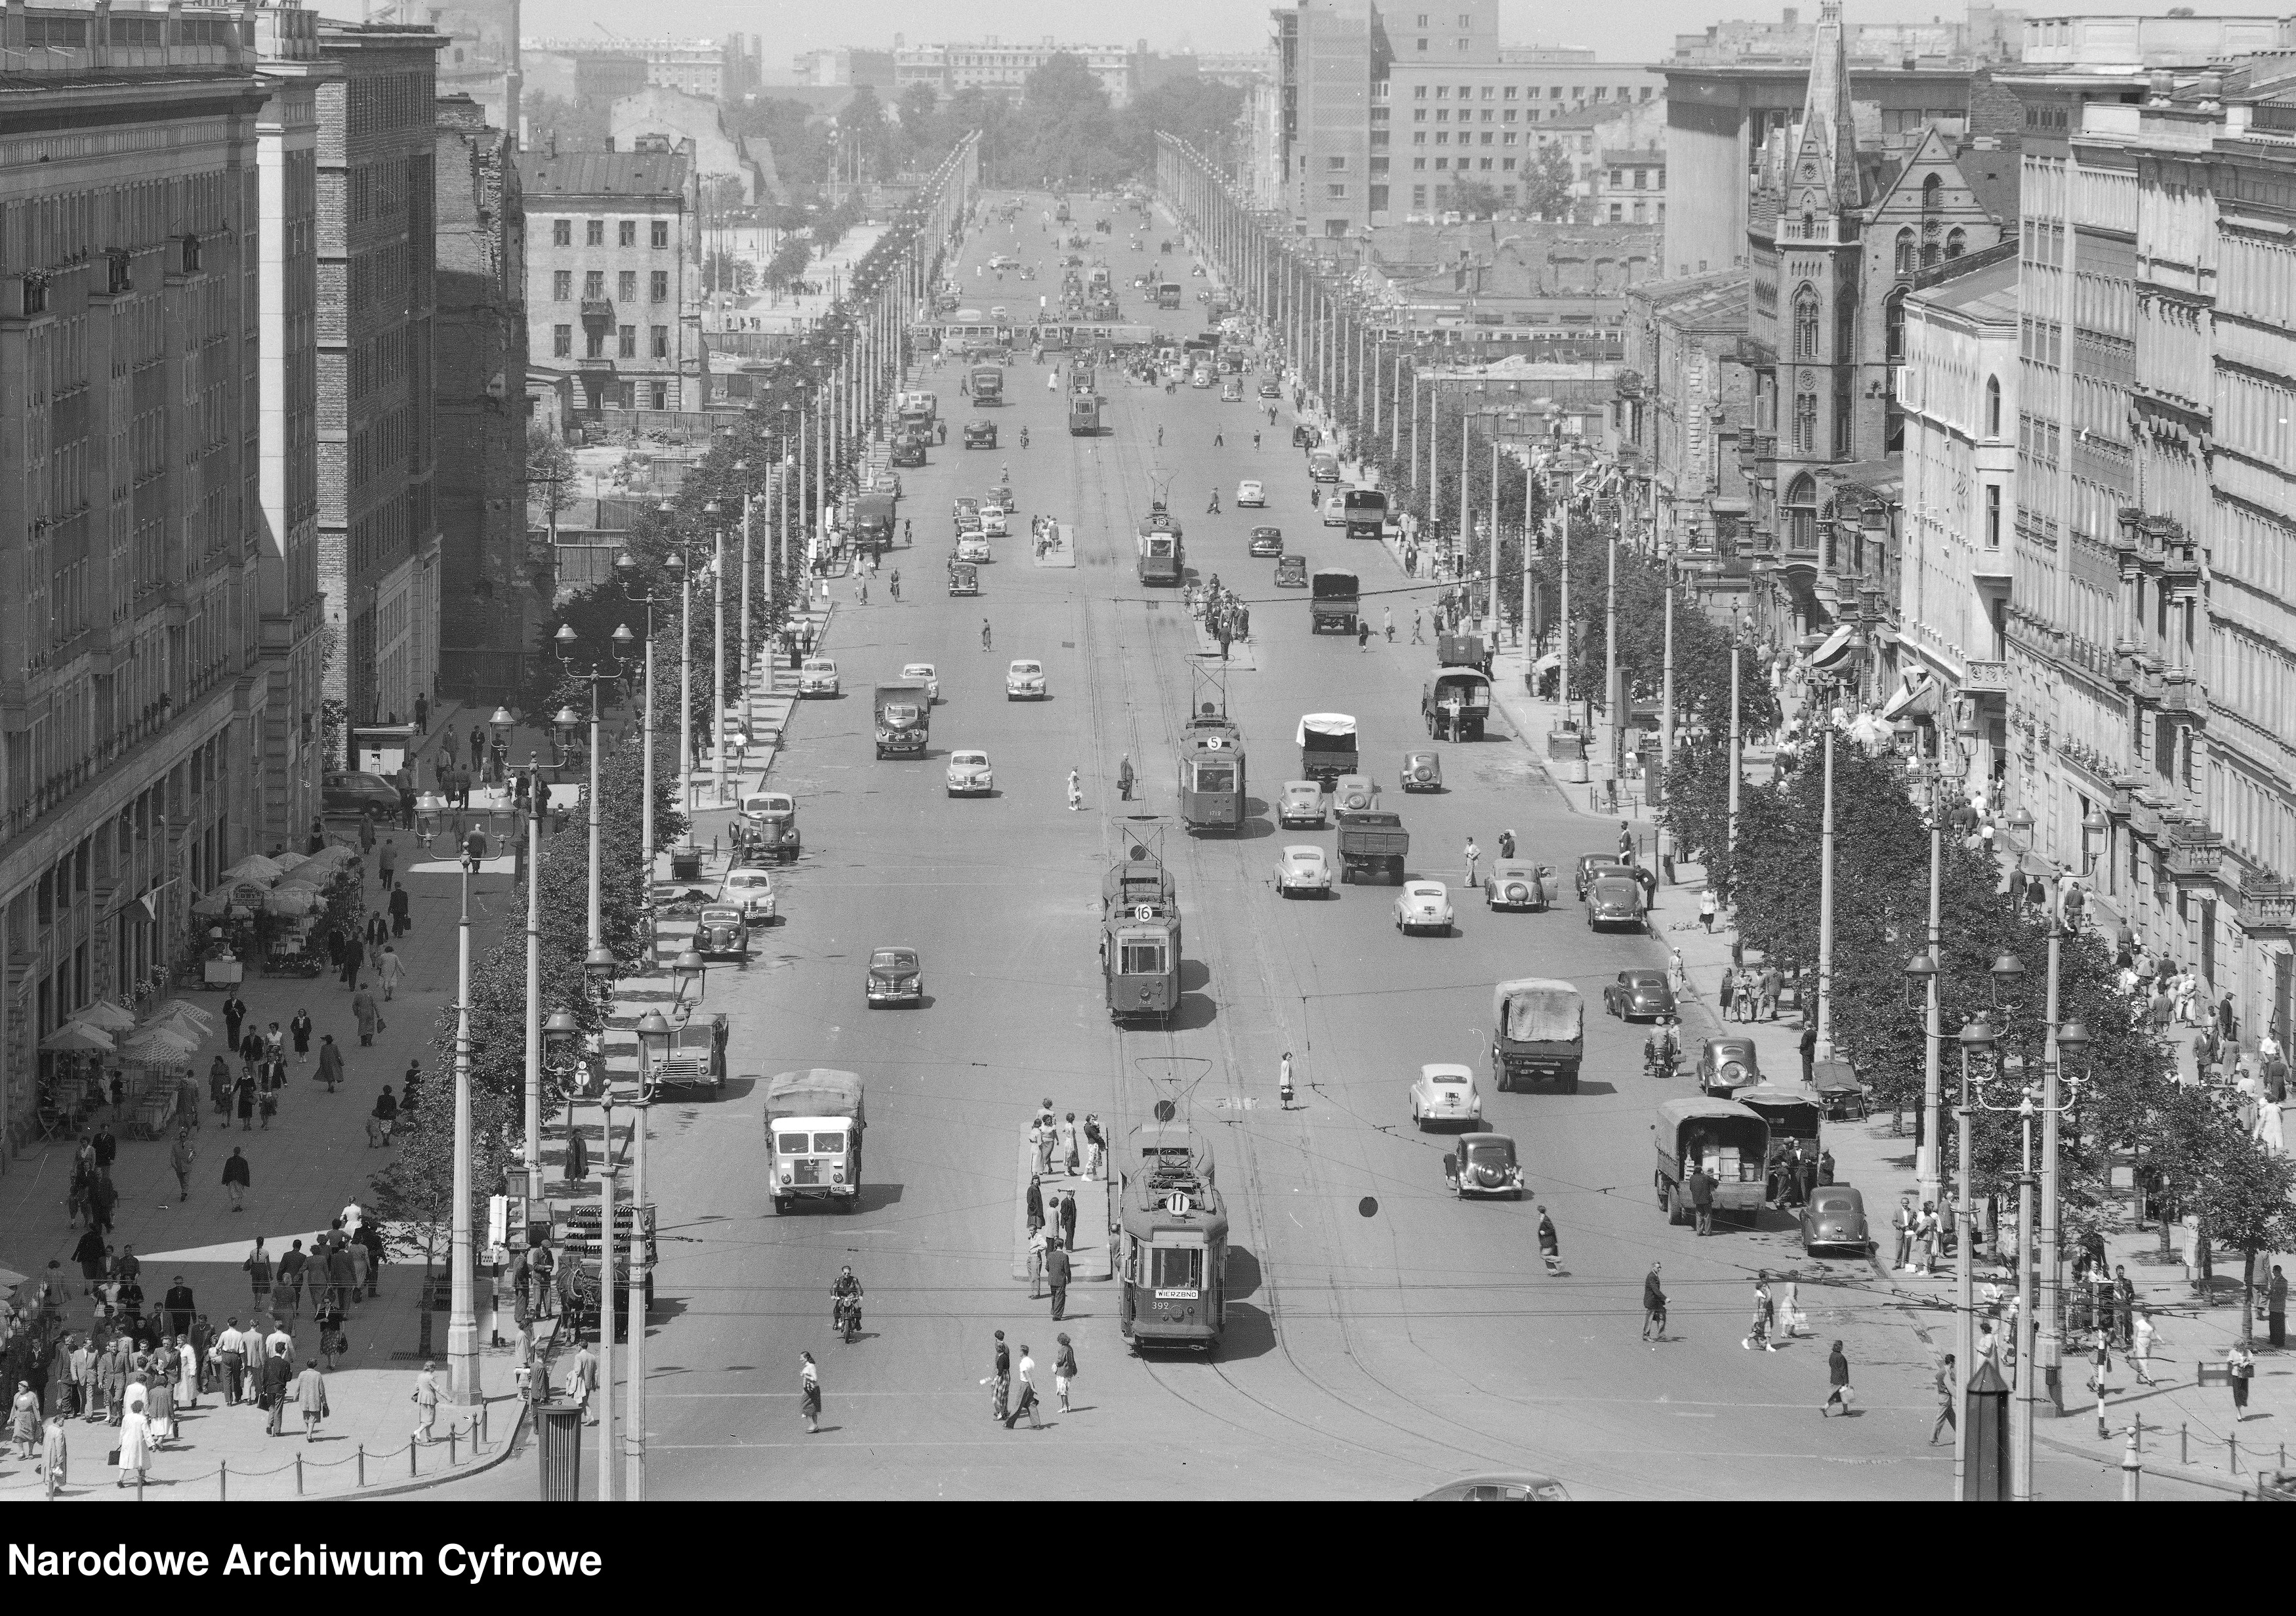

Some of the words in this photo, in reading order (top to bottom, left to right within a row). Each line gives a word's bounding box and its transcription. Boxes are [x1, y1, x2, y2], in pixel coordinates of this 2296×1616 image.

[1210, 737, 1218, 749] 5
[1138, 905, 1151, 919] 16
[577, 1072, 587, 1085] T
[1172, 1193, 1183, 1211] 11
